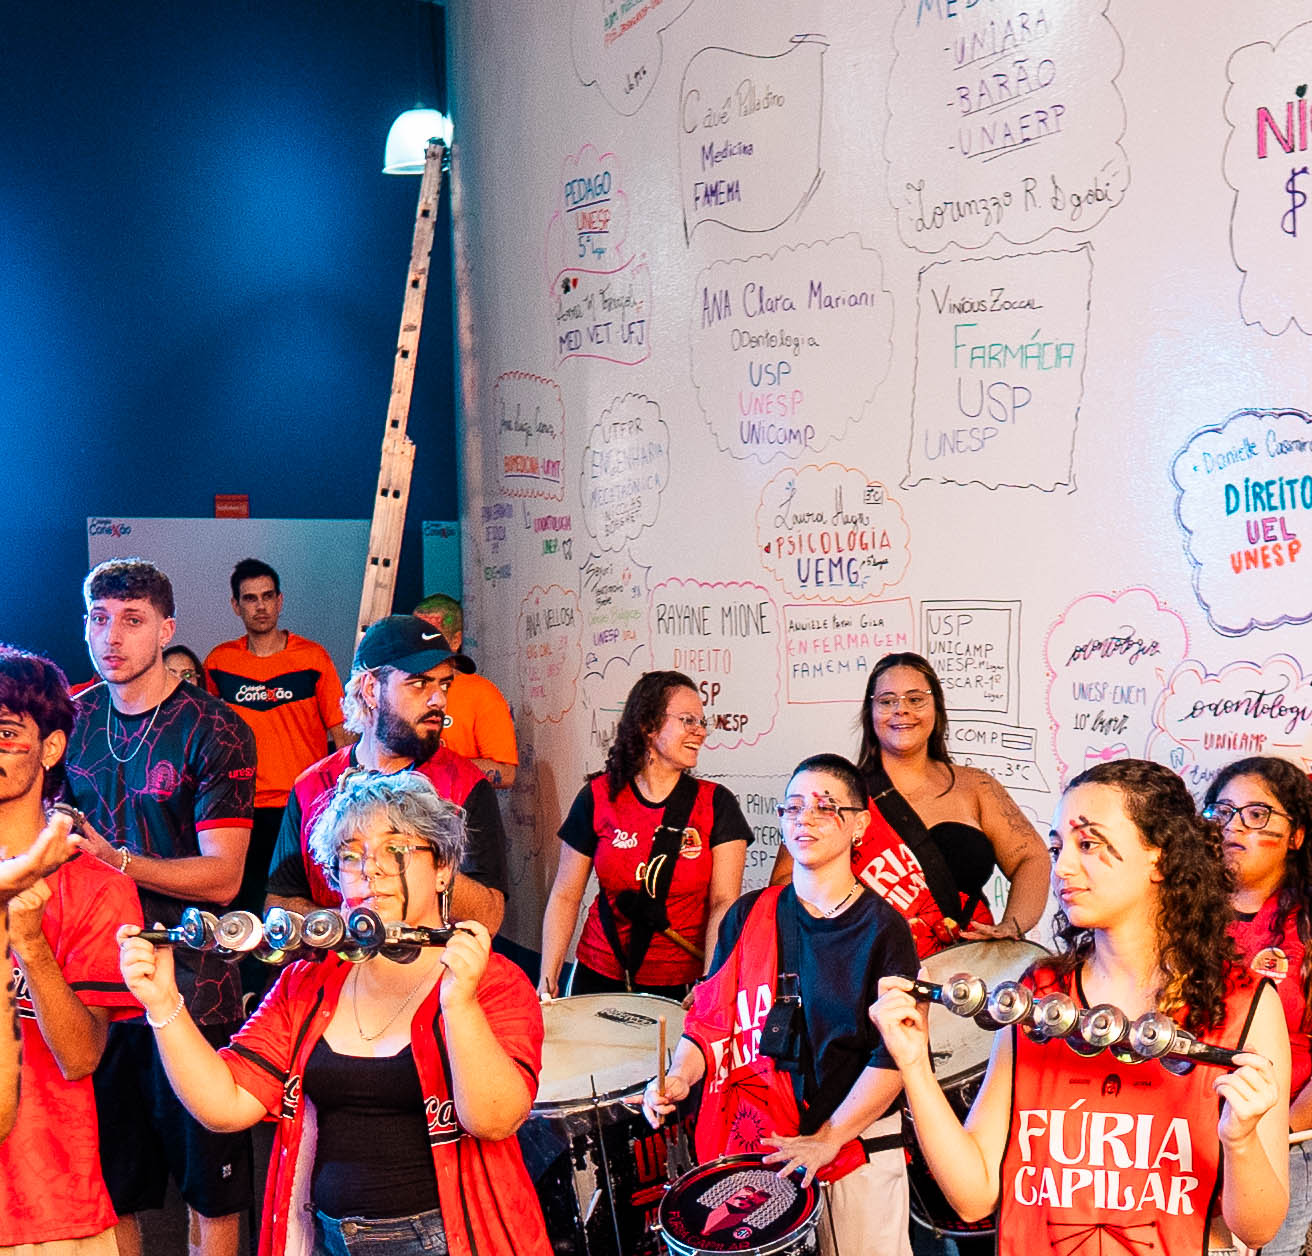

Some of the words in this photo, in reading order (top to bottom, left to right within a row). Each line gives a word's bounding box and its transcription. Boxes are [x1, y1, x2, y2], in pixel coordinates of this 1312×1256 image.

[702, 286, 732, 330] ANA
[743, 282, 797, 319] Clara
[807, 279, 875, 310] Mariani
[954, 324, 1076, 371] FARMÁCIA
[749, 361, 792, 388] USP
[738, 390, 804, 417] UNESP
[959, 377, 1033, 424] USP
[925, 427, 999, 460] UNESP
[1246, 516, 1298, 544] UEL
[798, 556, 860, 585] UEMG
[1230, 538, 1302, 575] UNESP
[656, 603, 712, 637] RAYANE
[929, 613, 974, 637] USP
[674, 647, 732, 674] DIREITO
[930, 640, 995, 659] UNICAMP
[792, 656, 868, 679] FAMEMA
[1018, 1098, 1195, 1173] FÚRIA
[1014, 1164, 1200, 1216] CAPILAR
